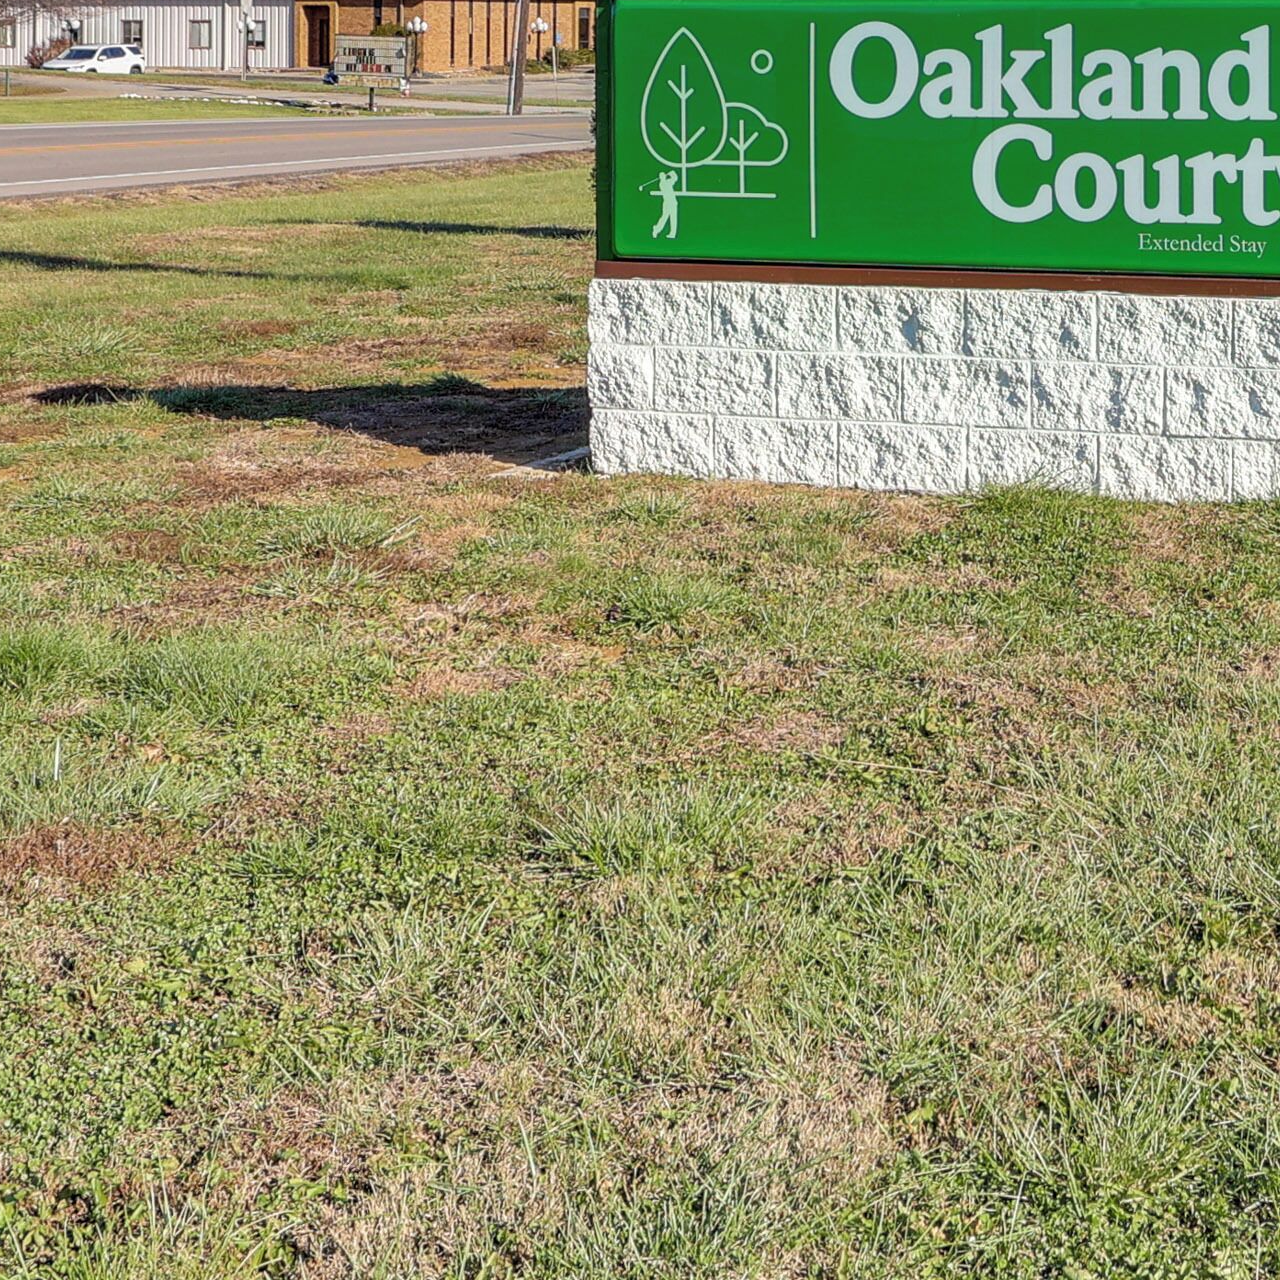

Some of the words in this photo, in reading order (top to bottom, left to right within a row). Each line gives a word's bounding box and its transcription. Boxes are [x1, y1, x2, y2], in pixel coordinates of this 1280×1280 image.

[828, 20, 1278, 122] Oakland
[1138, 233, 1224, 253] Extended
[1229, 235, 1267, 258] Stay
